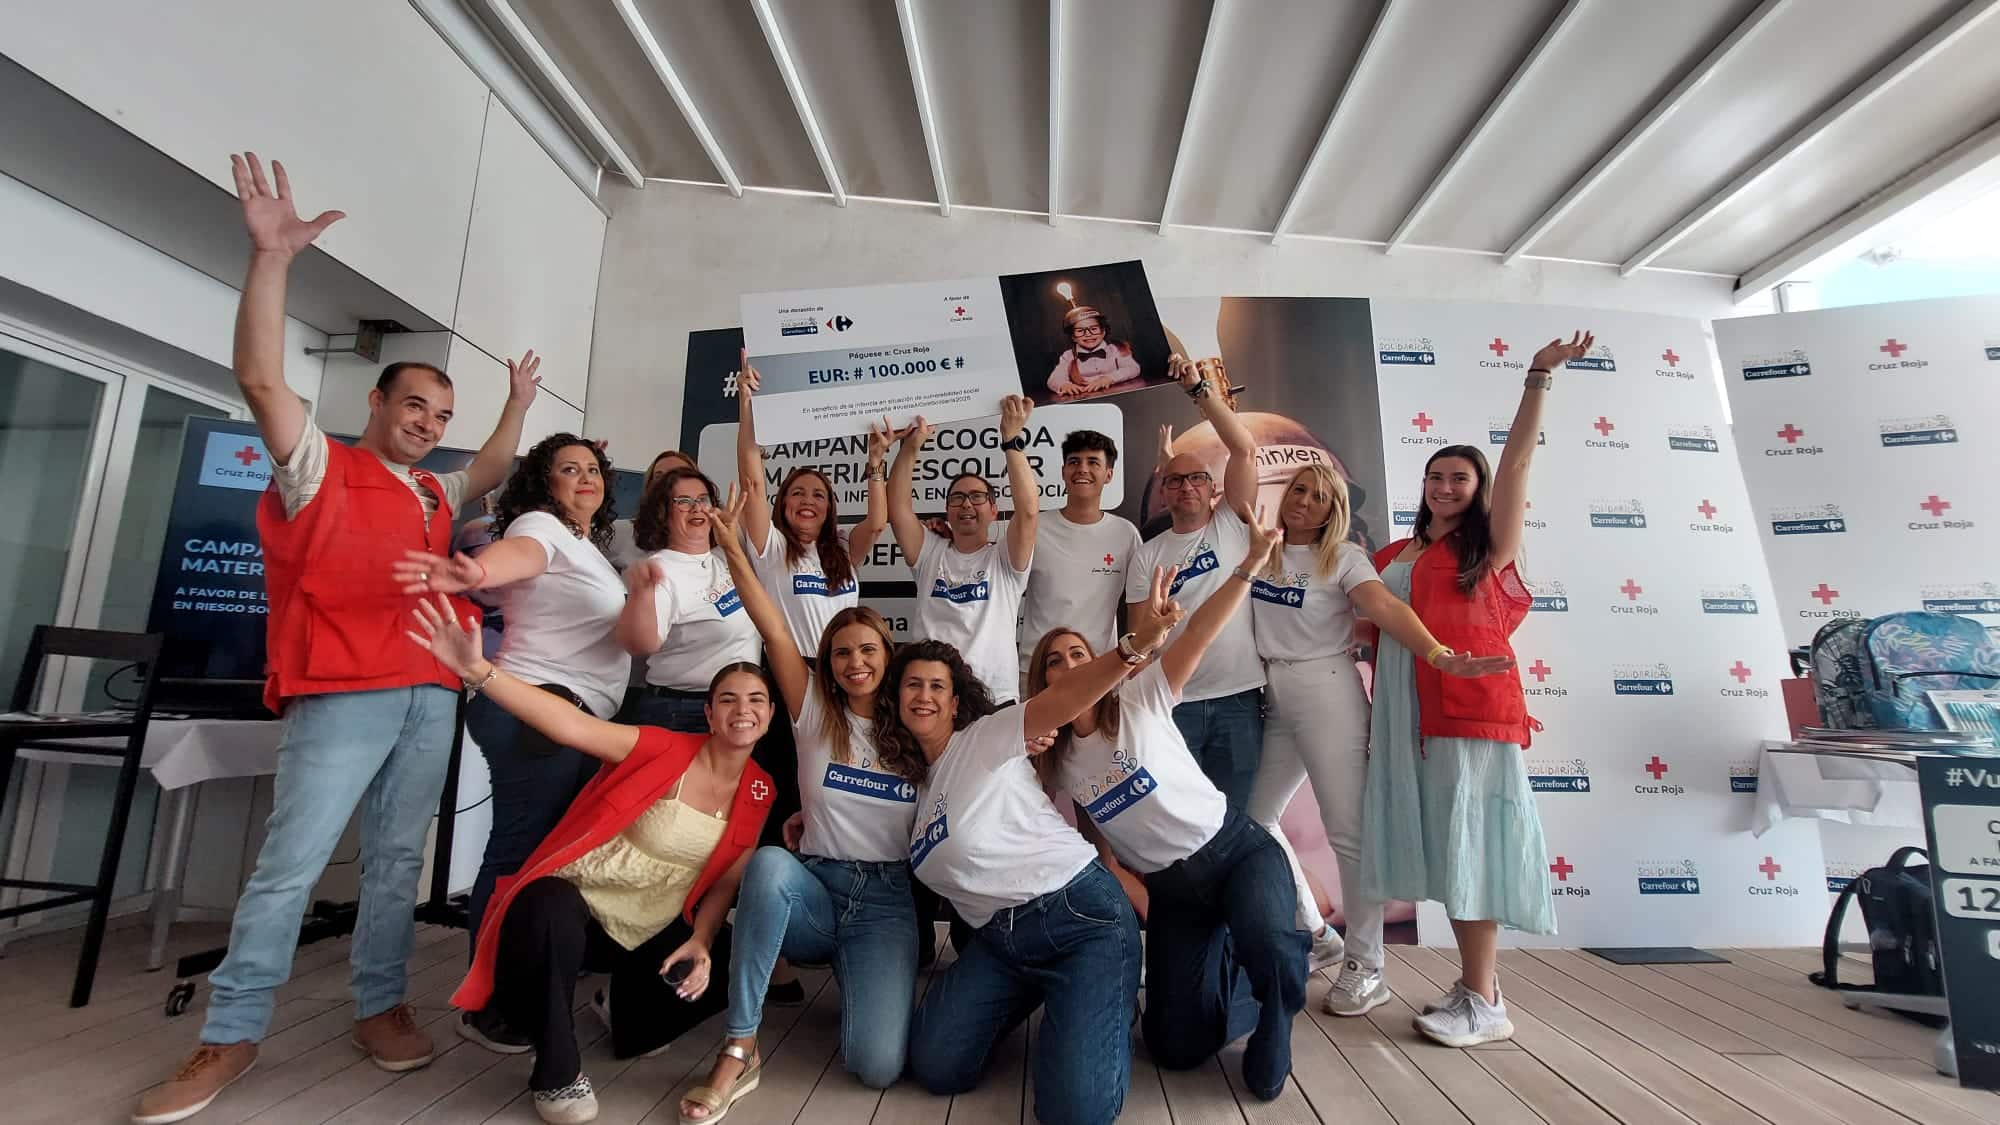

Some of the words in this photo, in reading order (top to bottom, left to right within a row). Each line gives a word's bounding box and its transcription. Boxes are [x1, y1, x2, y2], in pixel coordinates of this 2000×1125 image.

[849, 350, 882, 360] Páguese
[893, 348, 911, 356] Cruz
[913, 346, 930, 354] Roja
[1382, 354, 1417, 362] Carrefour
[808, 368, 849, 384] EUR:
[854, 367, 863, 380] #
[869, 359, 936, 378] 100.000
[941, 358, 951, 370] €
[955, 356, 964, 369] #
[1503, 361, 1524, 370] Roja
[1868, 361, 1897, 371] Cruz
[1900, 360, 1929, 369] Roja
[1655, 369, 1675, 378] Cruz
[1677, 371, 1695, 381] Roja
[1745, 368, 1788, 378] Carrefour
[1401, 436, 1424, 445] Cruz
[1427, 436, 1448, 446] Roja
[1585, 439, 1607, 448] Cruz
[1609, 440, 1630, 450] Roja
[1765, 448, 1794, 457] Cruz
[1796, 446, 1824, 456] Roja
[215, 467, 244, 478] Cruz
[247, 470, 273, 482] Roja
[1524, 520, 1547, 530] Roja
[1592, 517, 1627, 525] Carrefour
[1908, 522, 1940, 531] Cruz
[1943, 520, 1975, 530] Roja
[1690, 523, 1711, 532] Cruz
[1713, 524, 1734, 534] Roja
[1775, 523, 1820, 532] Carrefour
[175, 587, 186, 596] A
[189, 587, 237, 599] FAVOR
[239, 591, 258, 600] DE
[173, 601, 192, 610] EN
[194, 602, 246, 613] RIESGO
[1610, 605, 1634, 614] Cruz
[1636, 606, 1659, 616] Roja
[1799, 610, 1829, 618] Cruz
[1832, 609, 1861, 618] Roja
[1522, 687, 1542, 696] ruz
[1544, 687, 1568, 697] Roja
[1616, 683, 1653, 692] Carrefour
[1720, 688, 1745, 697] Cruz
[1746, 688, 1769, 699] Roja
[828, 770, 889, 791] Carrefour
[1530, 780, 1569, 789] Carrefour
[1634, 785, 1659, 794] Cruz
[1661, 784, 1684, 796] Roja
[1641, 882, 1679, 890] Carrefour
[1748, 886, 1773, 895] Cruz
[1775, 886, 1799, 897] Roja
[1566, 886, 1591, 898] Roja
